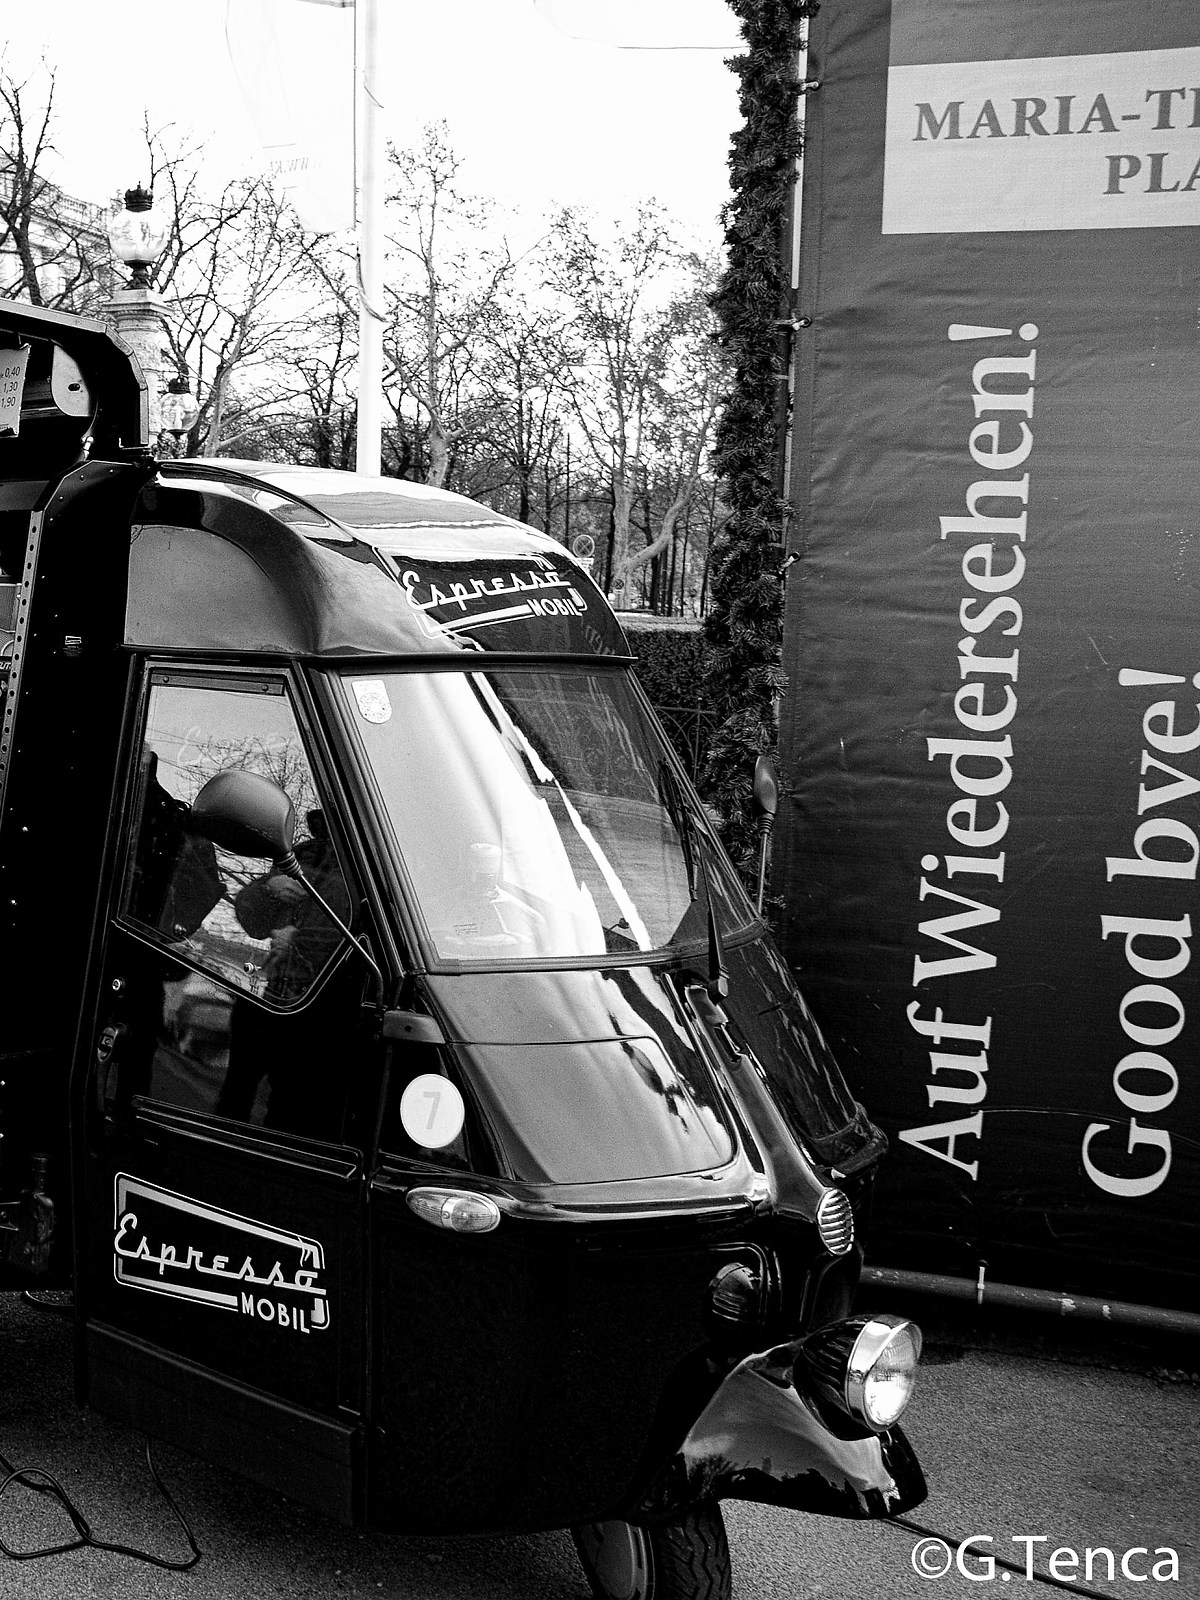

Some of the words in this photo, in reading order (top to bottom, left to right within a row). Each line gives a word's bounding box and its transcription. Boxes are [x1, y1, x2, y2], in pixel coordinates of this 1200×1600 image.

[912, 87, 1200, 141] MARIA-T
[2, 381, 19, 394] 1,30
[4, 366, 21, 379] 0,40
[0, 396, 16, 409] 1,90
[401, 569, 570, 611] Espresso
[527, 596, 583, 618] MOBIL
[913, 323, 1039, 986] Wiedersehen!
[1106, 668, 1200, 882] bye!
[1082, 913, 1193, 1197] Good
[422, 1090, 441, 1130] 7
[899, 1000, 992, 1180] Auf
[114, 1213, 327, 1295] Espresso
[240, 1291, 310, 1335] MOBIL
